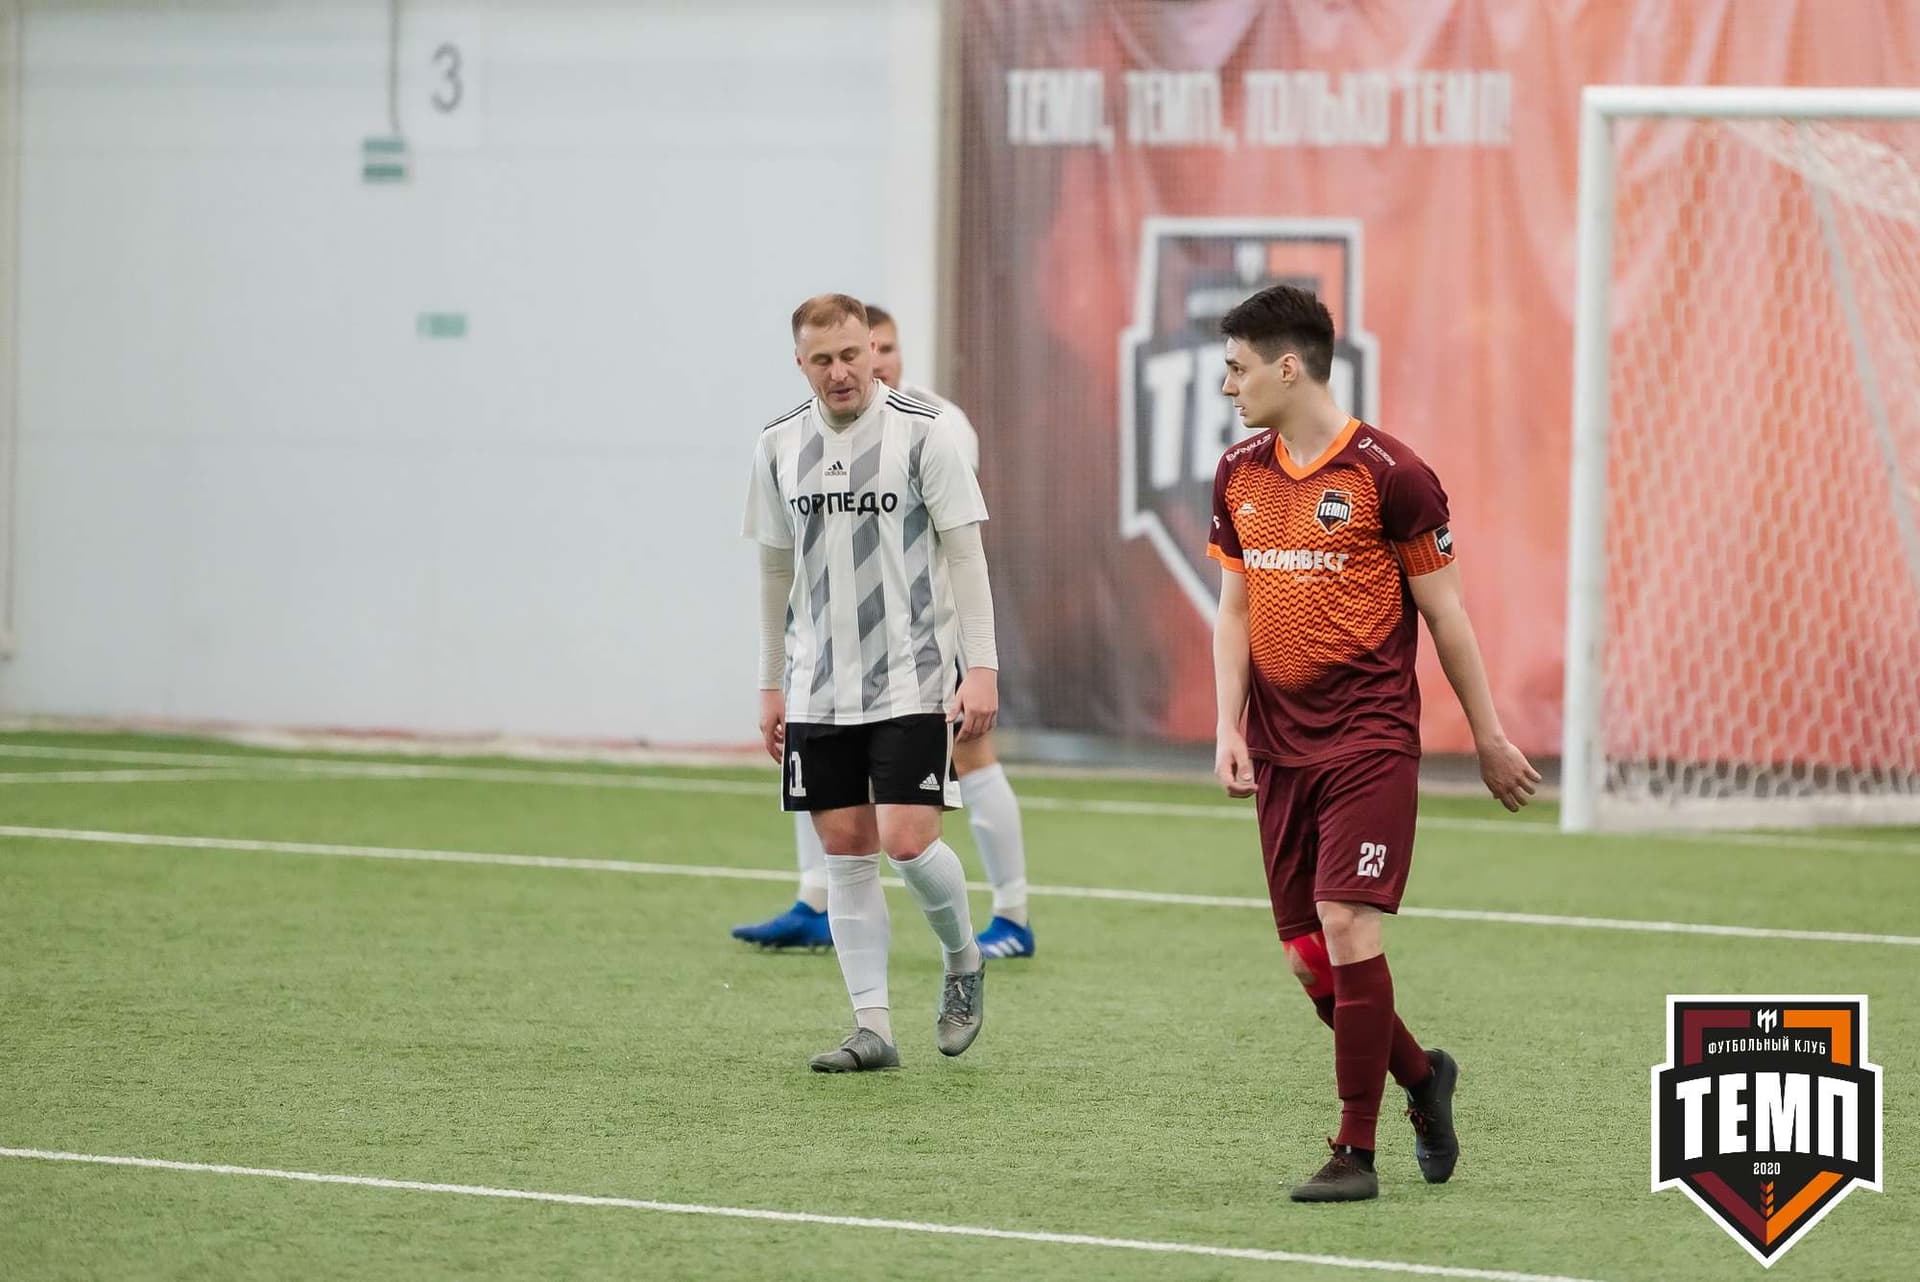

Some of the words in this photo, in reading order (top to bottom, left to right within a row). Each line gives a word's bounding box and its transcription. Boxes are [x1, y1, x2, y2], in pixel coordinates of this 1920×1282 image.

[430, 41, 463, 115] 3
[790, 491, 899, 517] ТОРПЕДО
[1319, 502, 1349, 520] ТЕМП
[1357, 842, 1387, 879] 23
